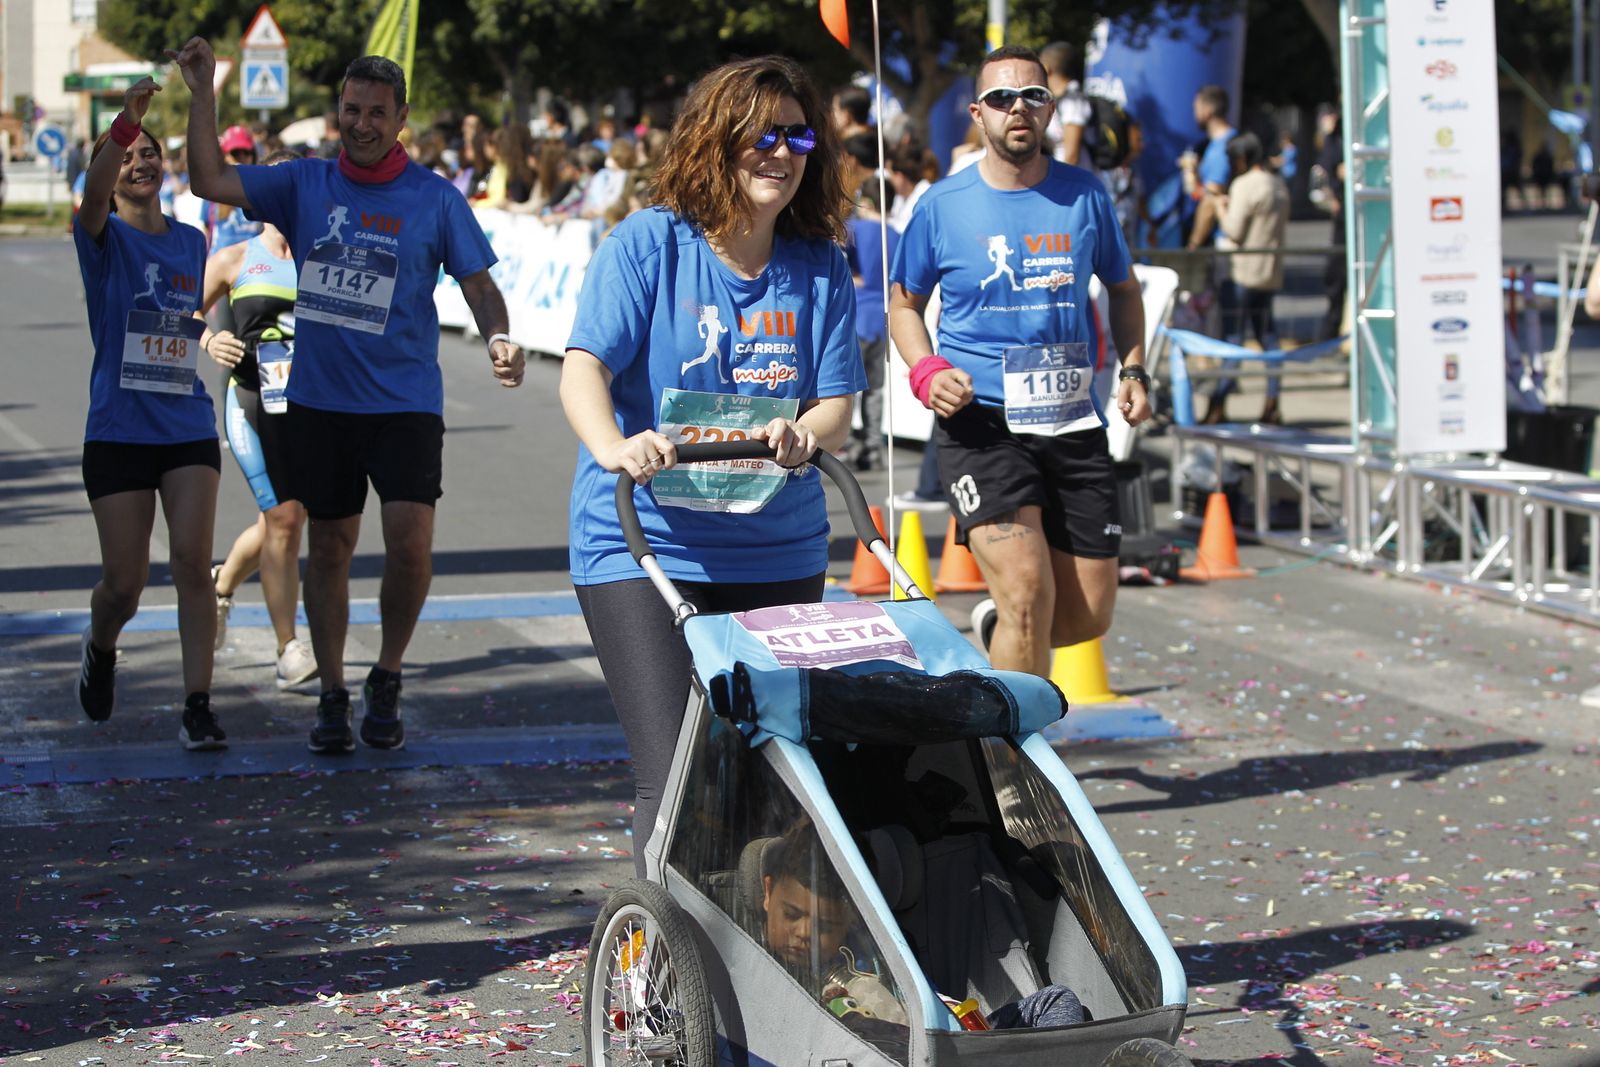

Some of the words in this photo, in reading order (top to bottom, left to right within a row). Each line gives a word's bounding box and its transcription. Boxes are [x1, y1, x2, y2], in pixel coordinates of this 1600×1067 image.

[361, 212, 402, 235] VIII
[354, 231, 399, 246] CARRERA
[1023, 233, 1072, 254] VIII
[248, 263, 273, 274] ego
[1023, 257, 1074, 267] CARRERA
[318, 265, 380, 294] 1147
[738, 311, 797, 337] VIII
[141, 335, 188, 357] 1148
[735, 343, 797, 354] CARRERA
[1023, 371, 1081, 395] 1189
[731, 396, 752, 405] VIII
[730, 460, 764, 469] MATEO
[766, 623, 895, 648] ATLETA
